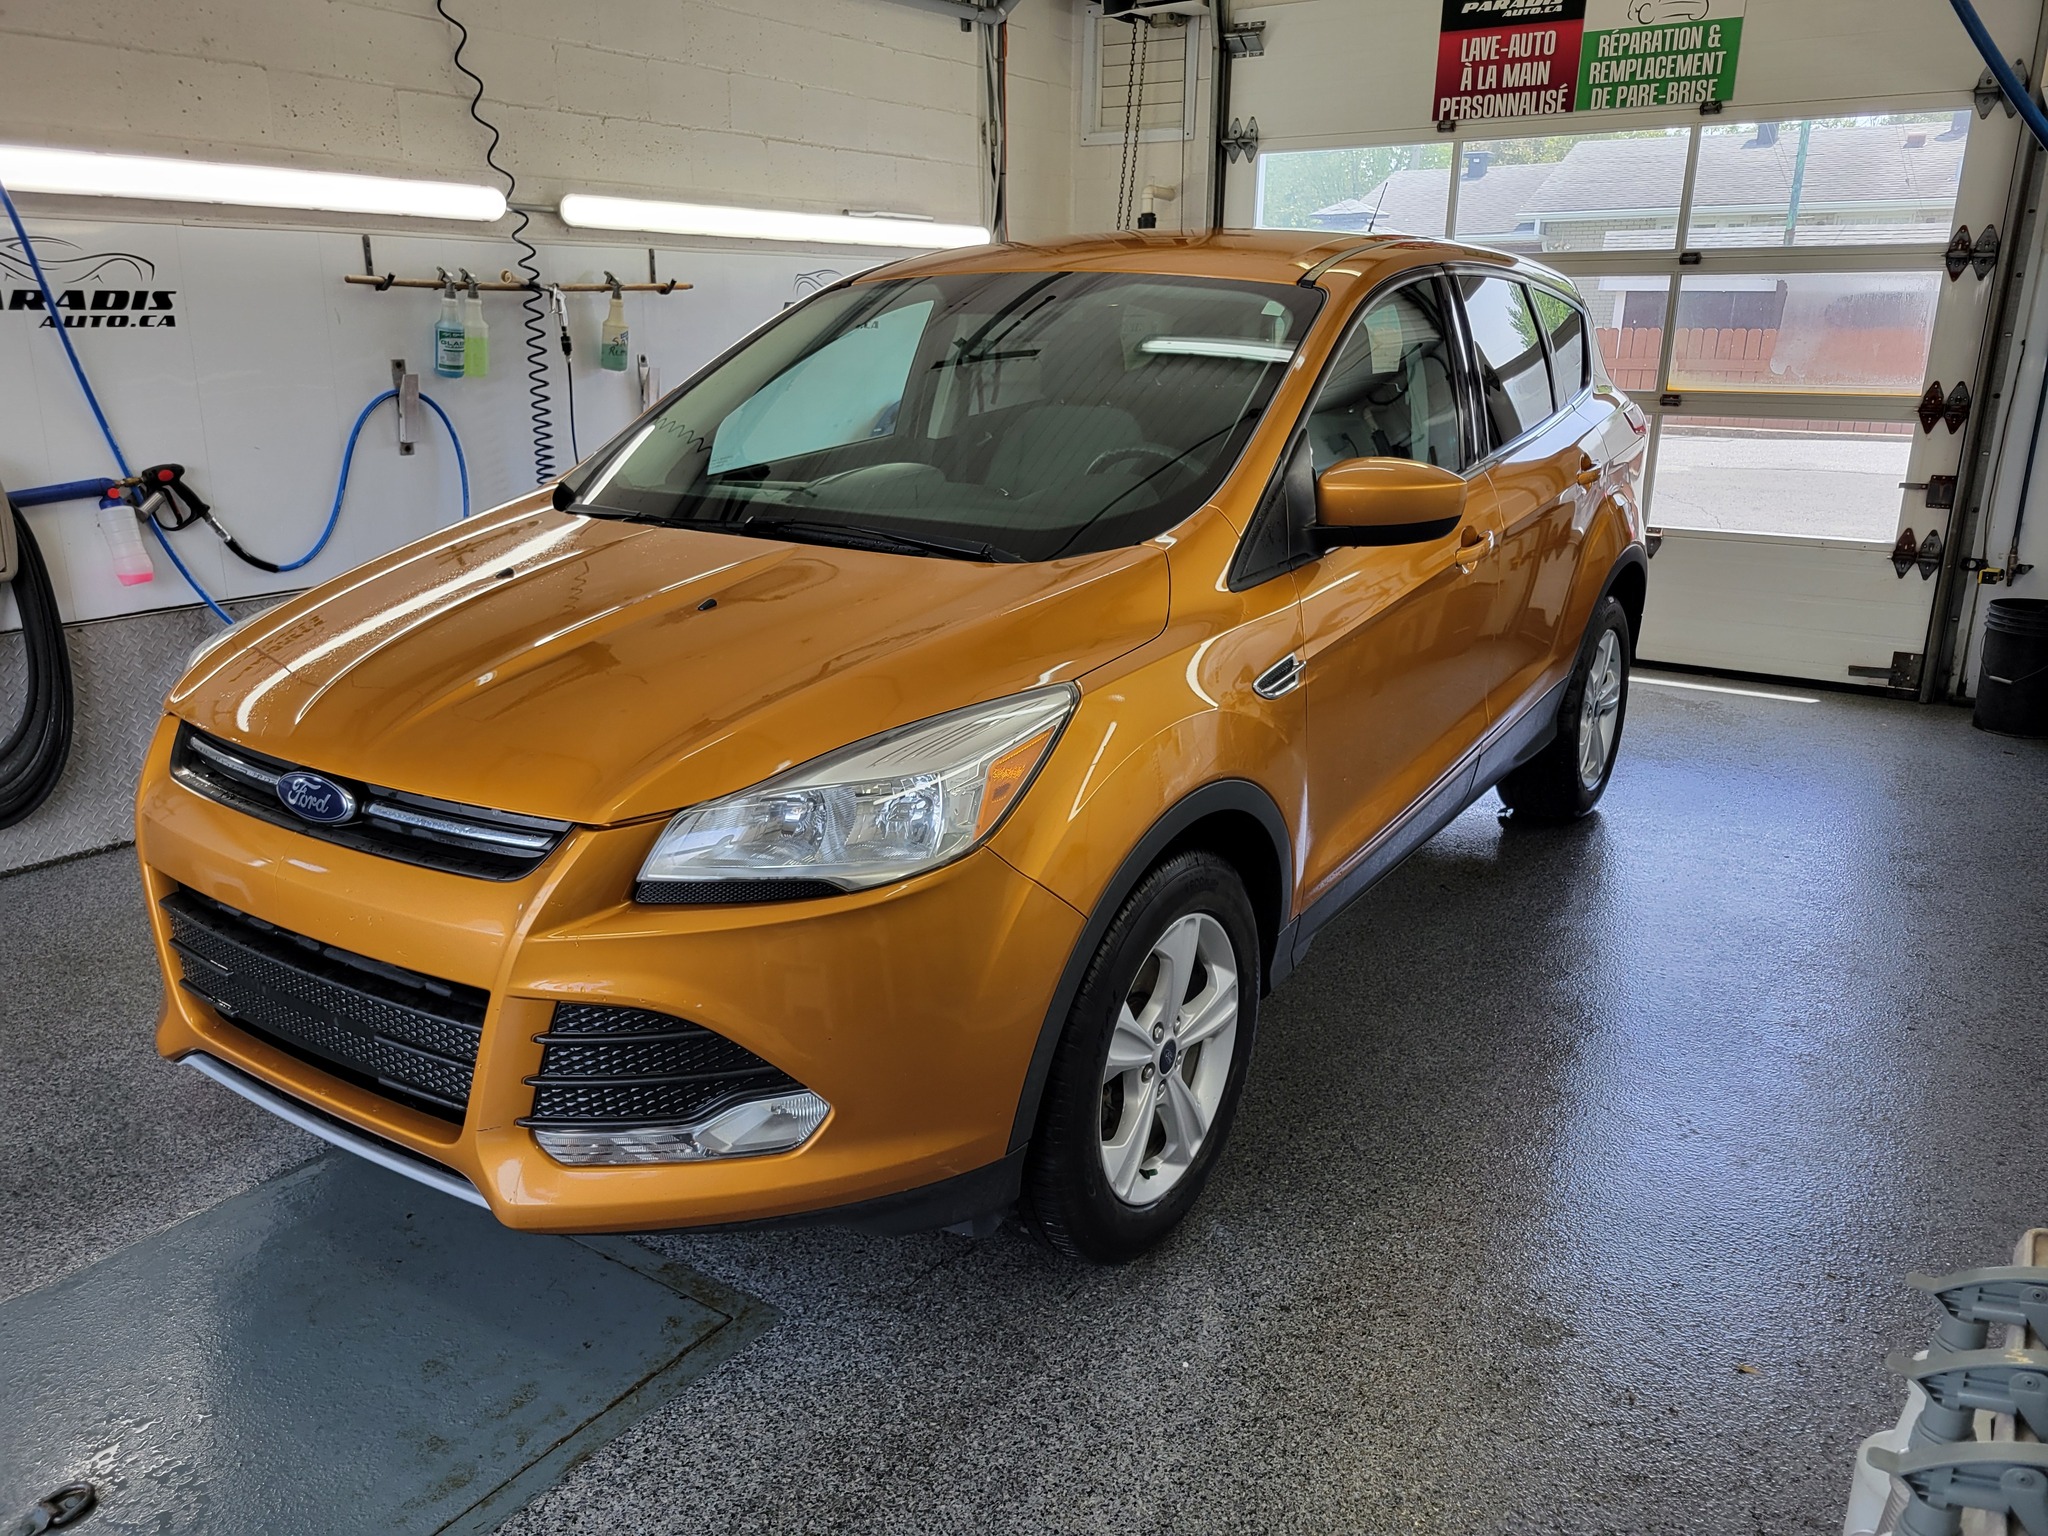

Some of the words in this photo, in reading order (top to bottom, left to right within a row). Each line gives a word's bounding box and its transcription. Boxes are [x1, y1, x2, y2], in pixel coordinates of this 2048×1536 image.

[1502, 4, 1563, 18] AUTO.CA
[1461, 30, 1557, 63] LAVE-AUTO
[1598, 25, 1703, 58] RÉPARATION
[1707, 24, 1722, 48] &
[1460, 62, 1472, 92] À
[1477, 65, 1497, 90] LA
[1502, 60, 1551, 88] MAIN
[1588, 51, 1727, 85] REMPLACEMENT
[1438, 83, 1568, 121] PERSONNALISÉ
[1590, 86, 1612, 111] DE
[1615, 78, 1718, 109] PARE-BRISE
[0, 289, 177, 311] RADIS
[38, 315, 176, 329] AUTO.CA
[287, 777, 332, 814] Ford
